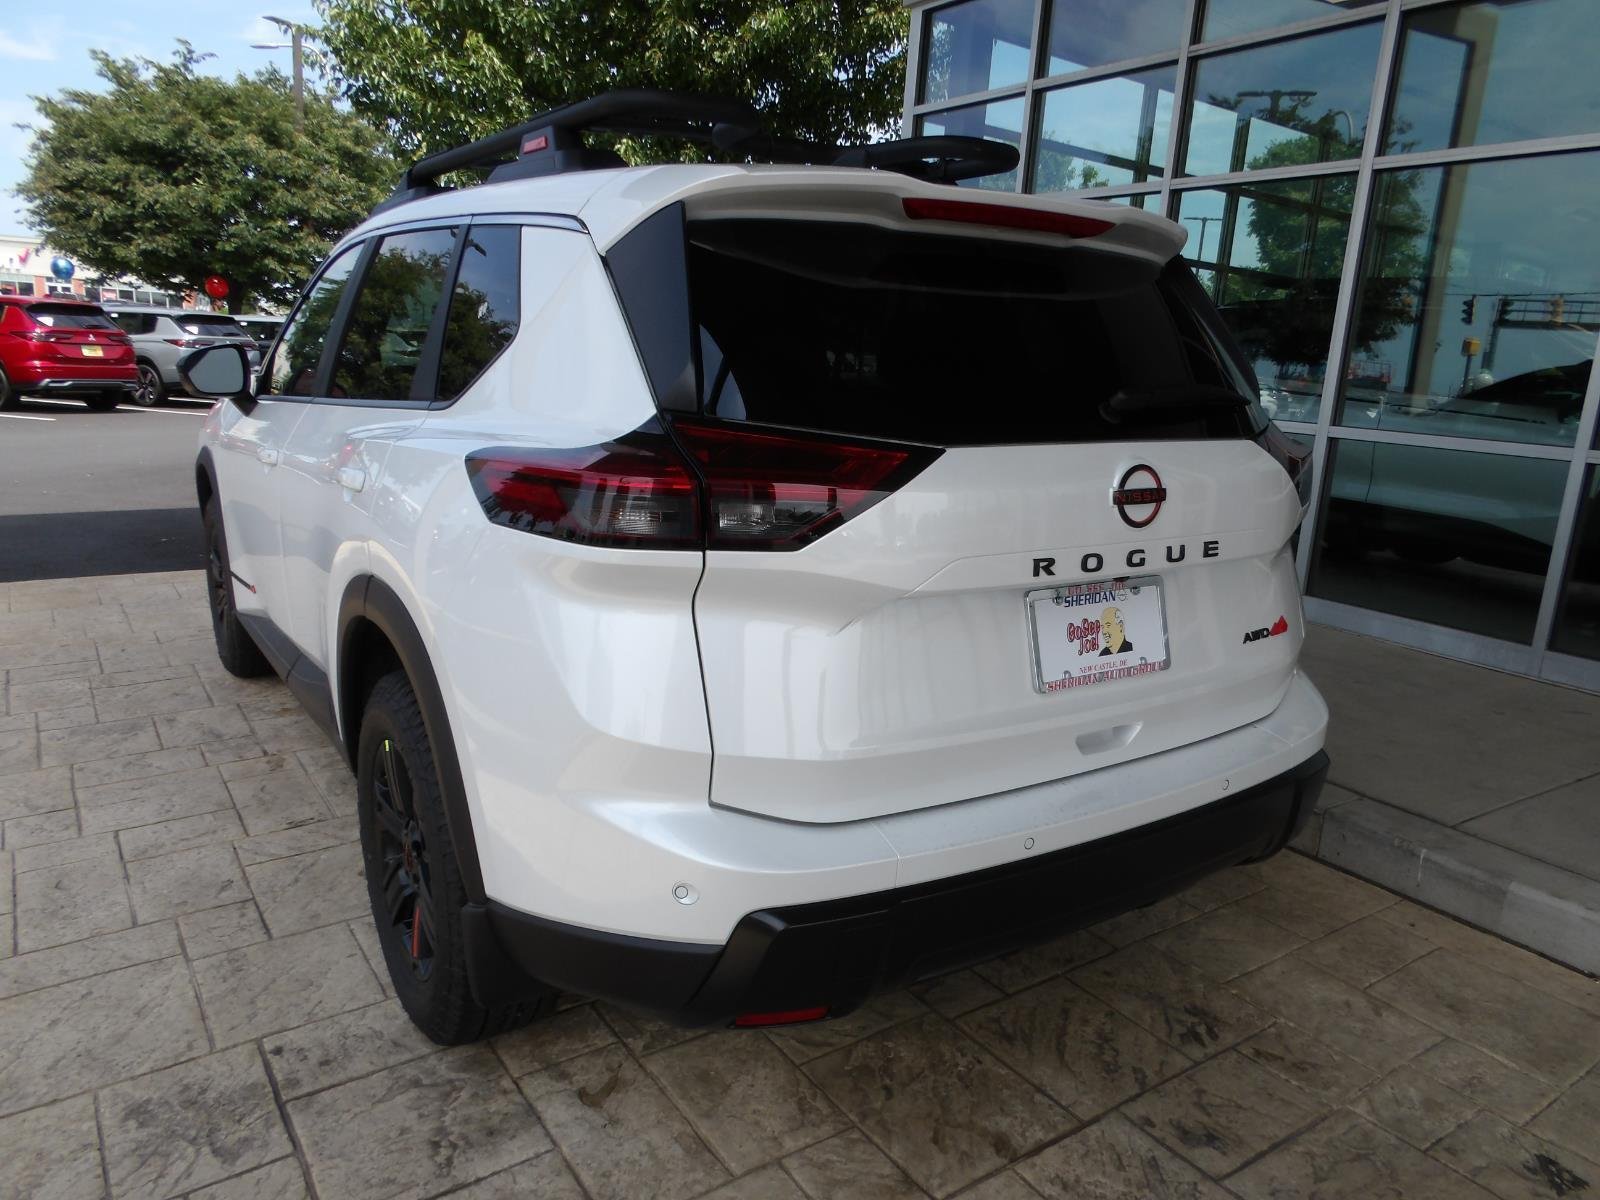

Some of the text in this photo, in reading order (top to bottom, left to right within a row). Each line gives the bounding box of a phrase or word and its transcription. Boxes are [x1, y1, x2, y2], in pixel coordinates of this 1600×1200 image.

[1033, 540, 1220, 577] ROGUE
[1064, 591, 1115, 607] SHERIDAN
[1242, 627, 1270, 645] AWD
[1079, 665, 1094, 674] NEW
[1046, 673, 1098, 692] SHERIDAN
